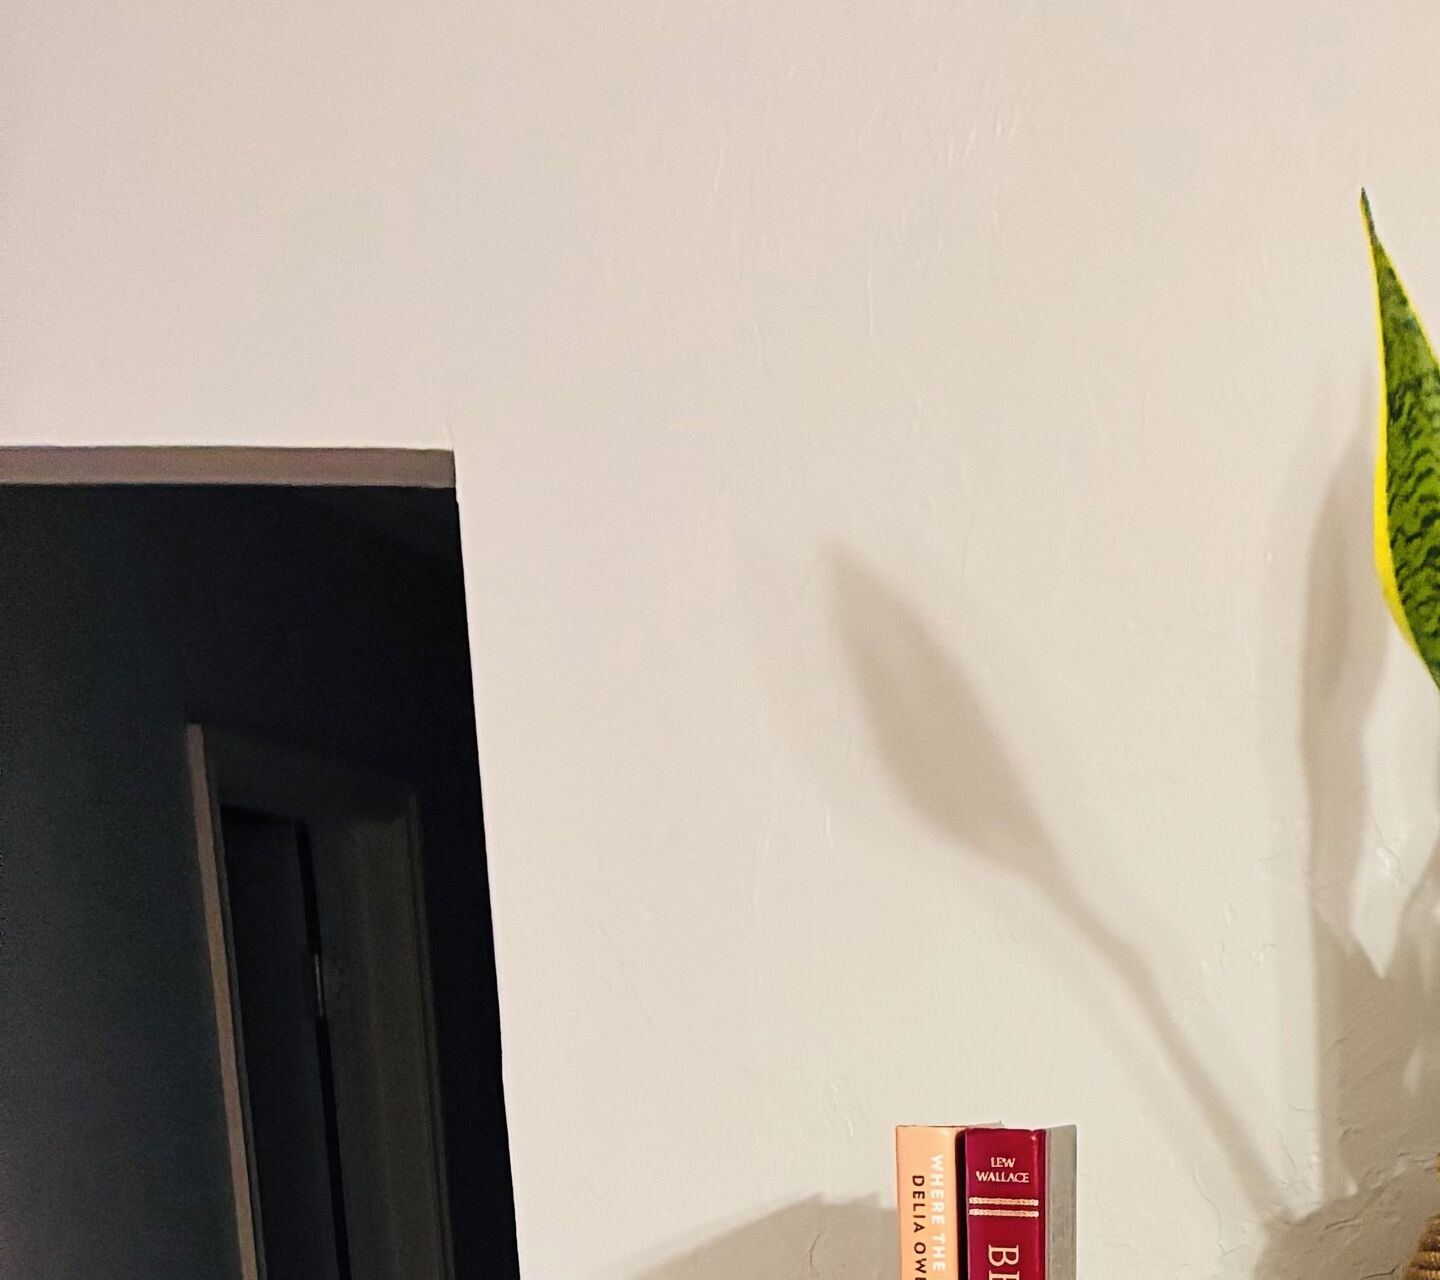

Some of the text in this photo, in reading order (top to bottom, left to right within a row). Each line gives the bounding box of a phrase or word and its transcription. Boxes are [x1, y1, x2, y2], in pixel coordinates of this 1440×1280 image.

[976, 1170, 1029, 1183] WALLACE
[990, 1157, 1016, 1168] LEW
[912, 1175, 926, 1233] DELIA
[930, 1154, 945, 1225] WHERE
[931, 1233, 946, 1272] THE
